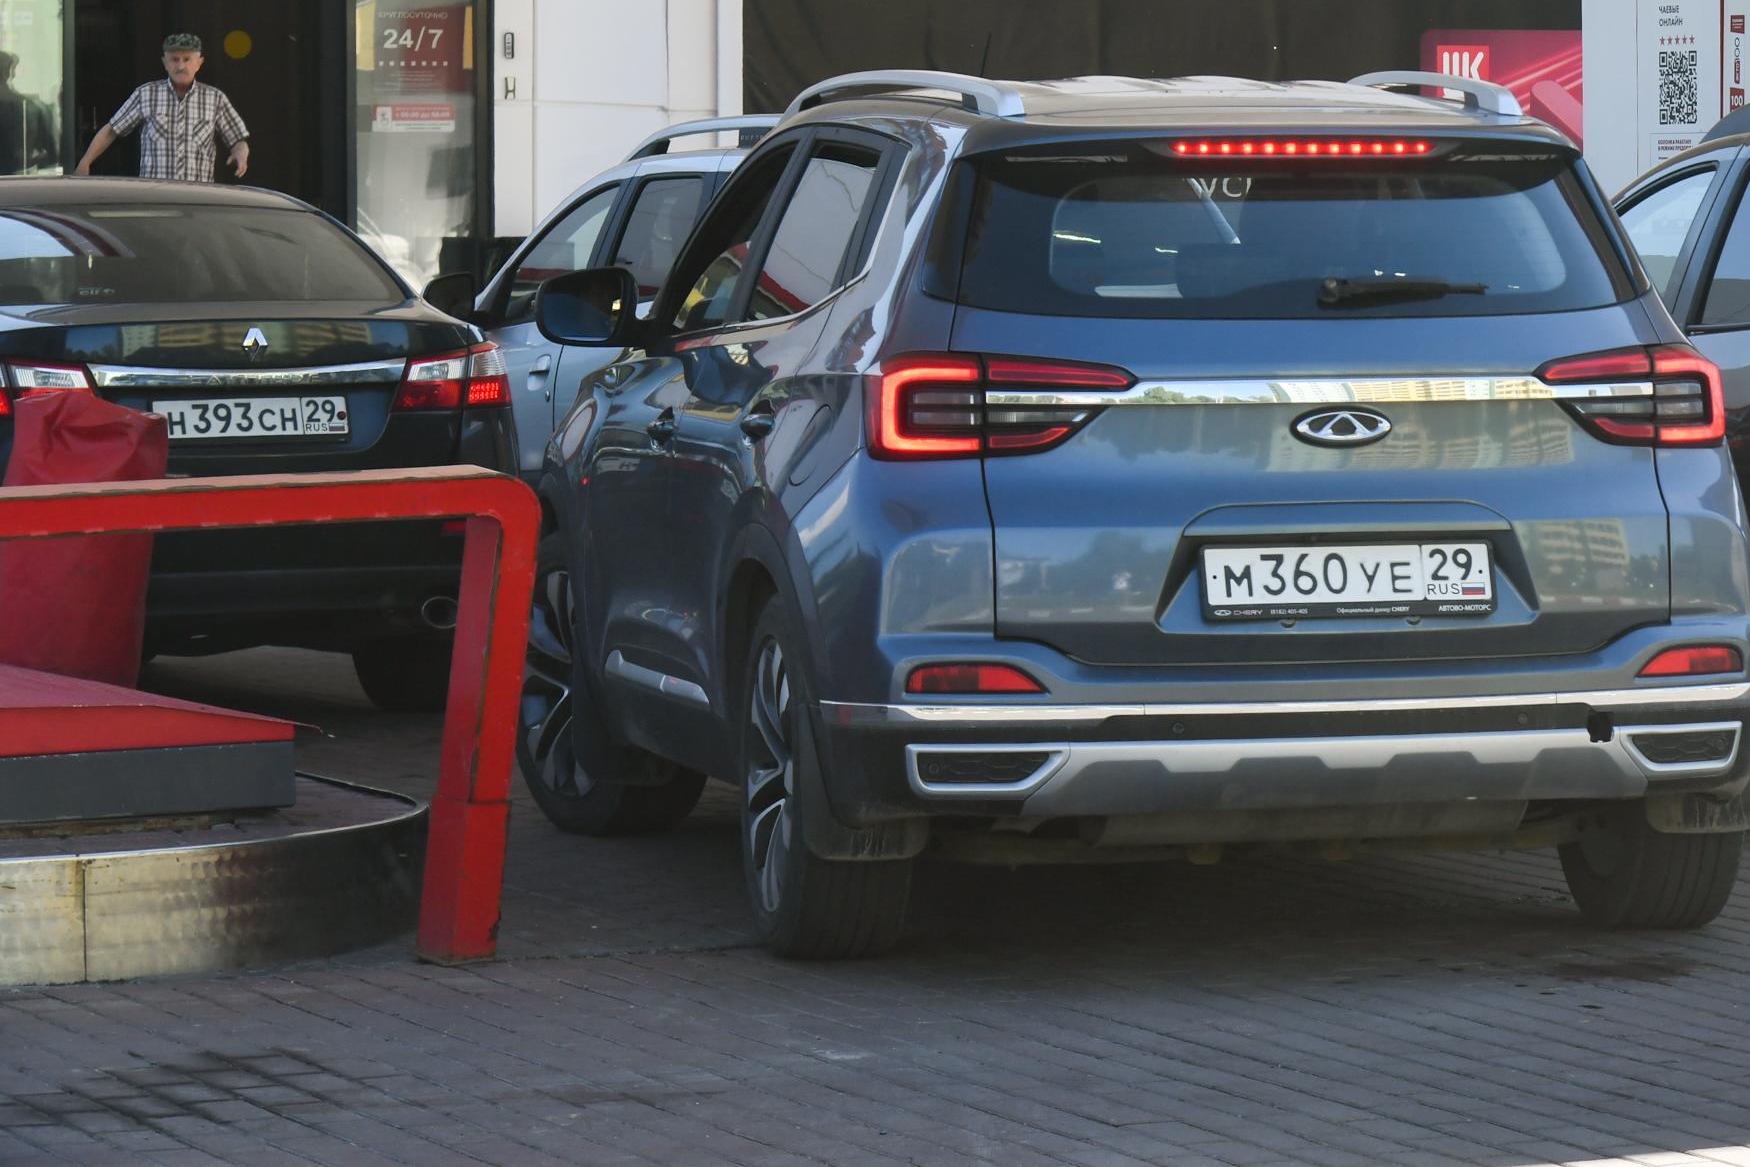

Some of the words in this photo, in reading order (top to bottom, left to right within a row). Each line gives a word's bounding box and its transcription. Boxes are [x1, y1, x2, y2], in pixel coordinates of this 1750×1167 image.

[1658, 5, 1680, 14] ЧАЕВЫЕ
[1658, 16, 1683, 27] ОНЛАЙН
[383, 26, 444, 52] 24/7
[1731, 95, 1743, 106] 100
[167, 401, 299, 436] Н393СН
[304, 399, 336, 422] 29
[305, 423, 328, 432] RUS
[1428, 548, 1473, 581] 29
[1427, 583, 1460, 595] RUS
[1438, 604, 1491, 612] АВТОВО-МОТОРС
